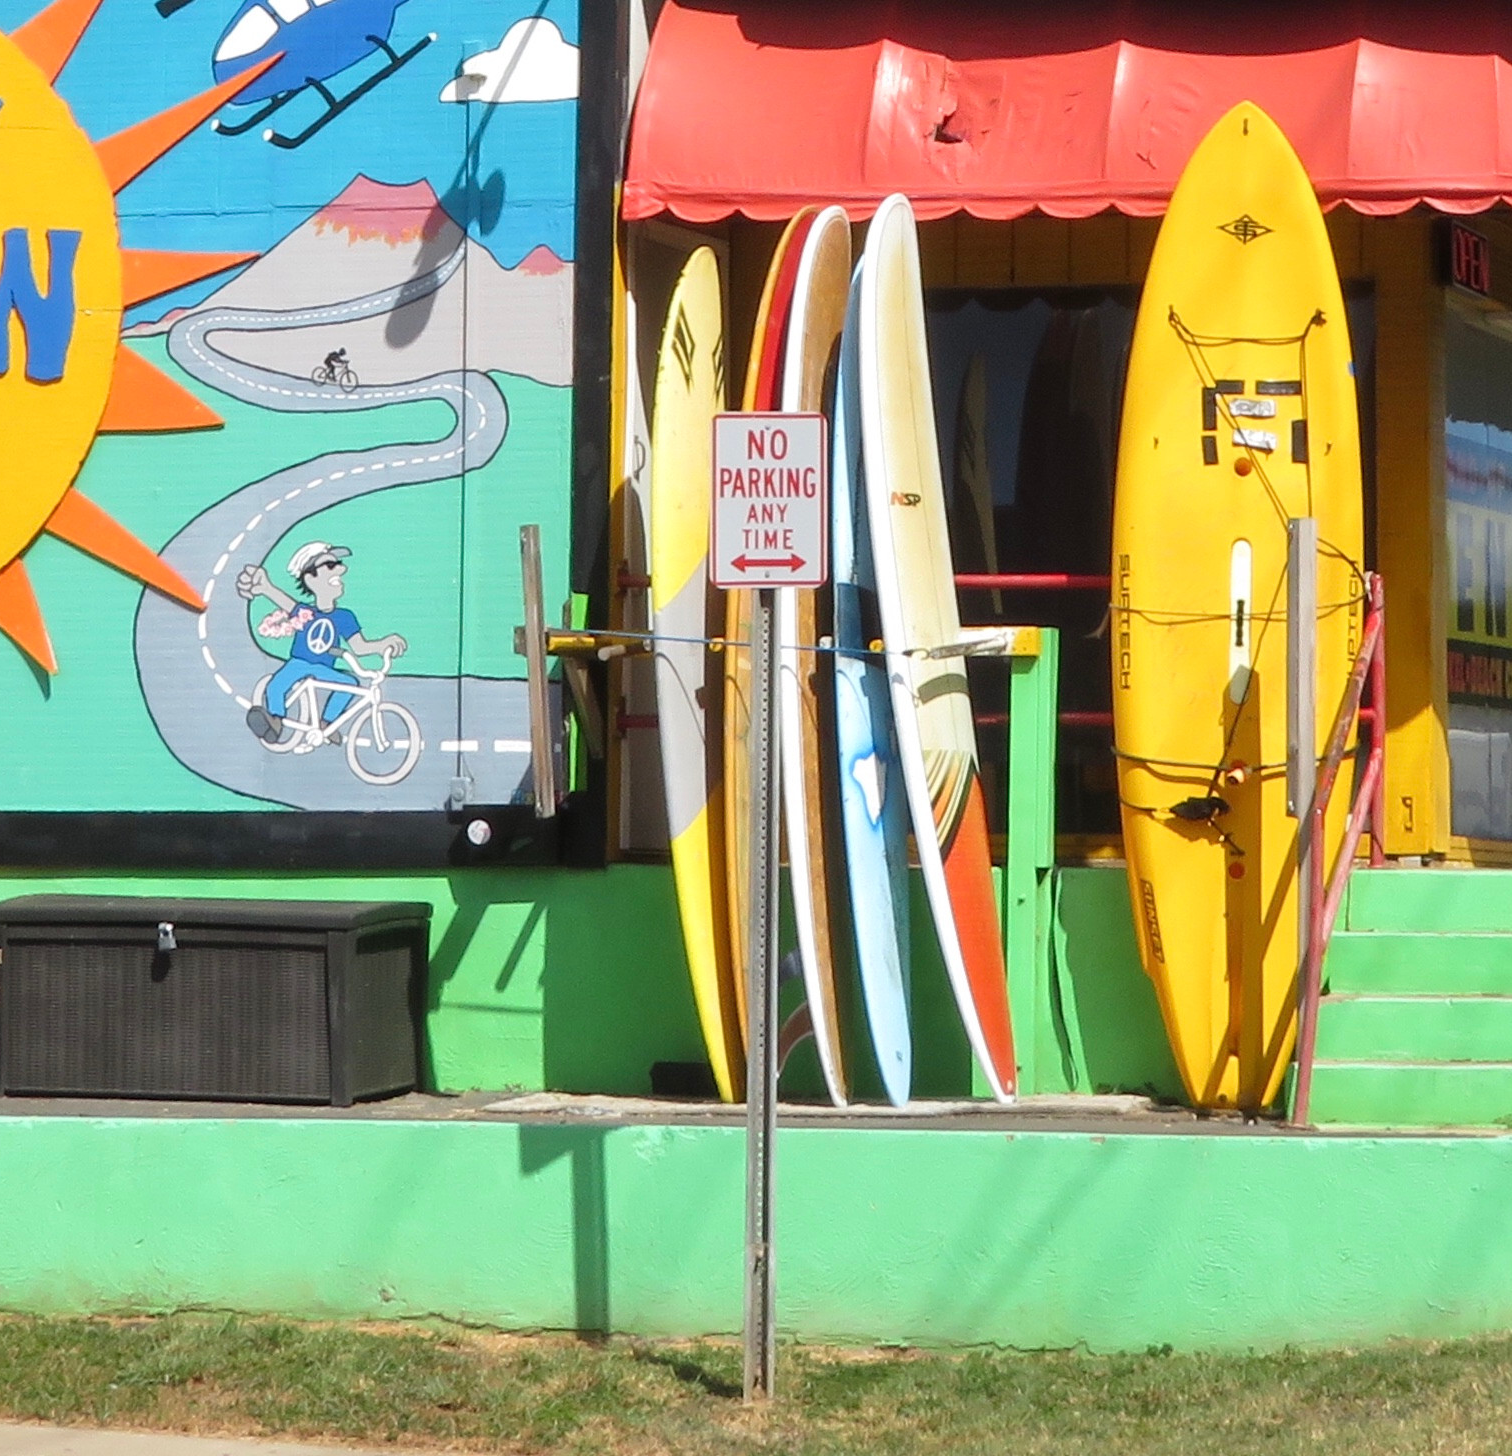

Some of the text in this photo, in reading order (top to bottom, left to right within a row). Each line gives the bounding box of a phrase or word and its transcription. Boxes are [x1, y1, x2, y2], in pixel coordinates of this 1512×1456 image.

[747, 429, 789, 461] NO
[719, 467, 817, 499] PARKING
[746, 503, 788, 524] ANY
[742, 529, 794, 550] TIME
